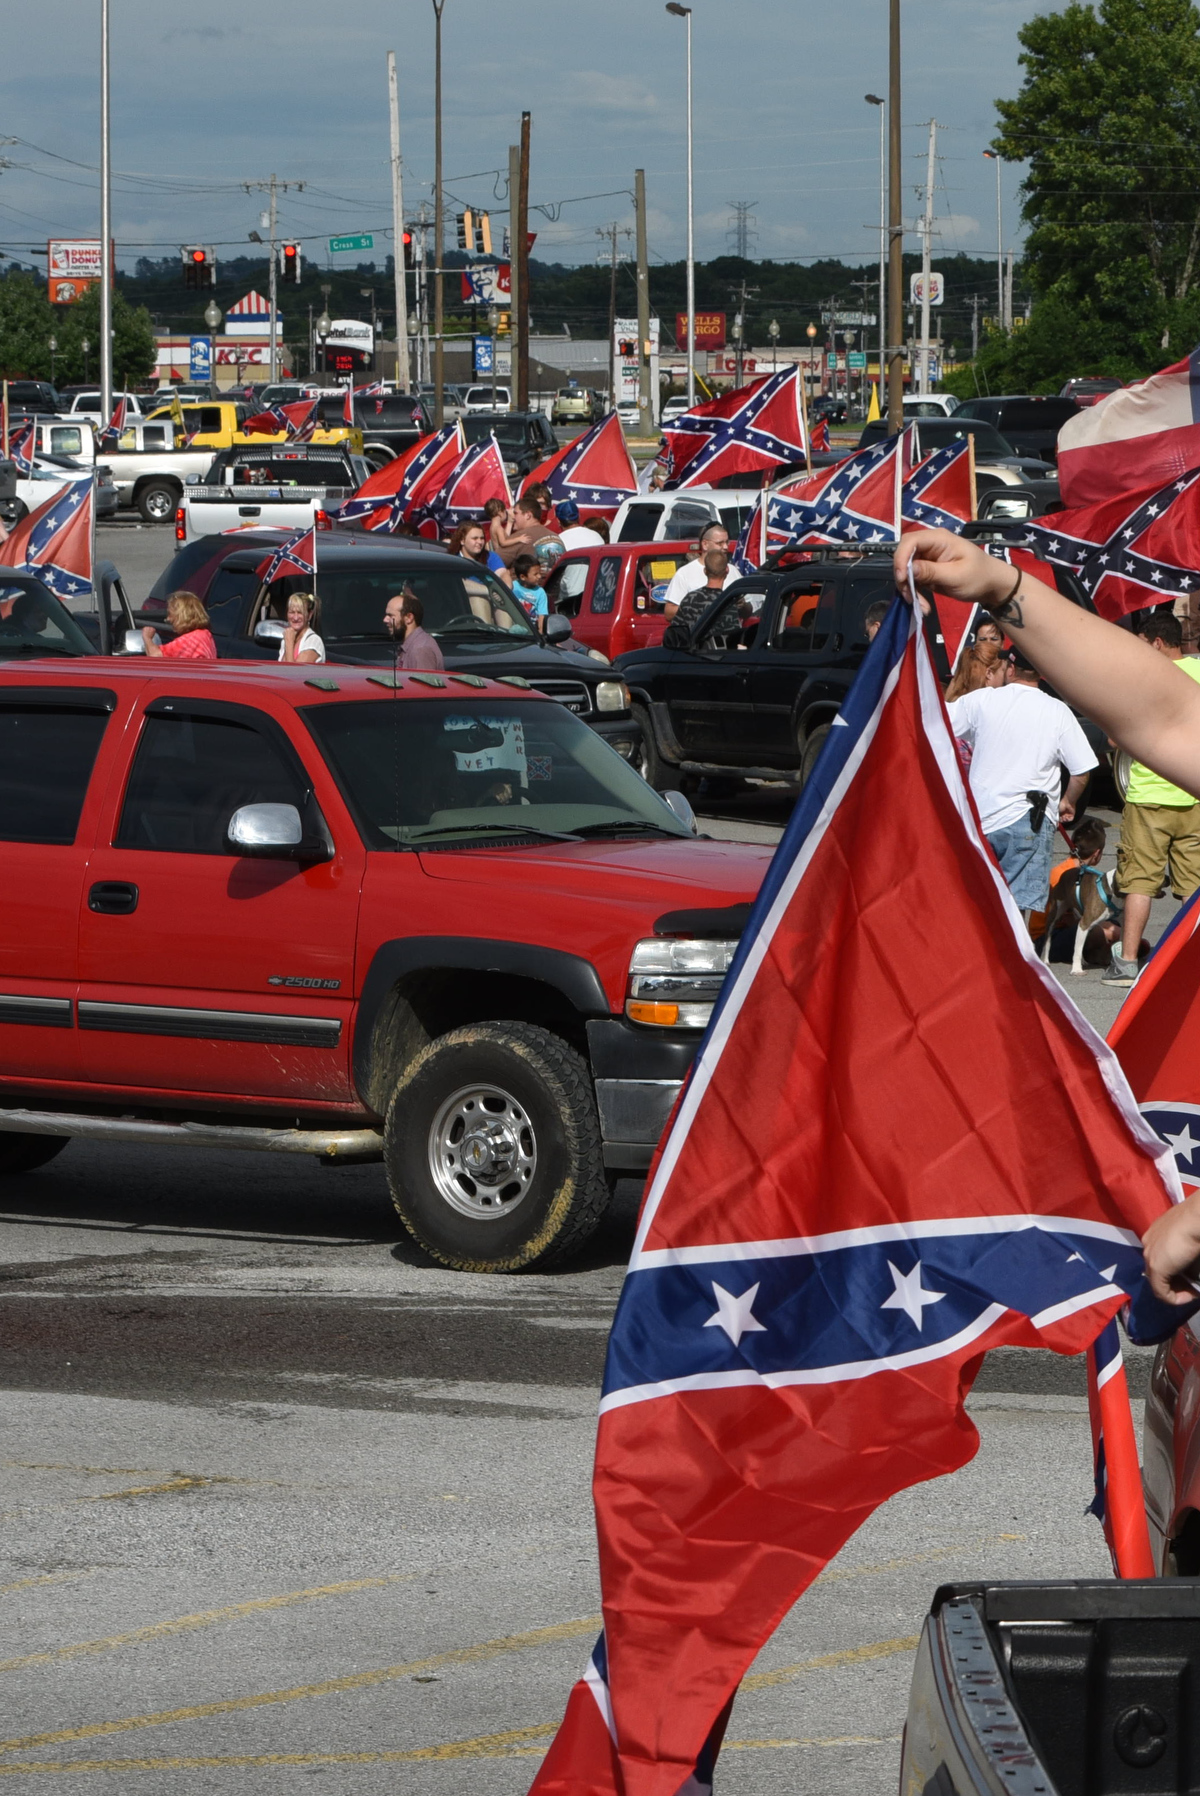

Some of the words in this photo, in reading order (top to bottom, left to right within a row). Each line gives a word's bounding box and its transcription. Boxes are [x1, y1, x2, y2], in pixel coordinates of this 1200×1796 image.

[332, 241, 354, 250] Cross
[361, 238, 370, 247] St
[216, 348, 262, 365] KFC
[512, 723, 523, 755] WAR
[464, 756, 494, 769] VET
[285, 976, 321, 988] 2500
[323, 980, 339, 989] HD
